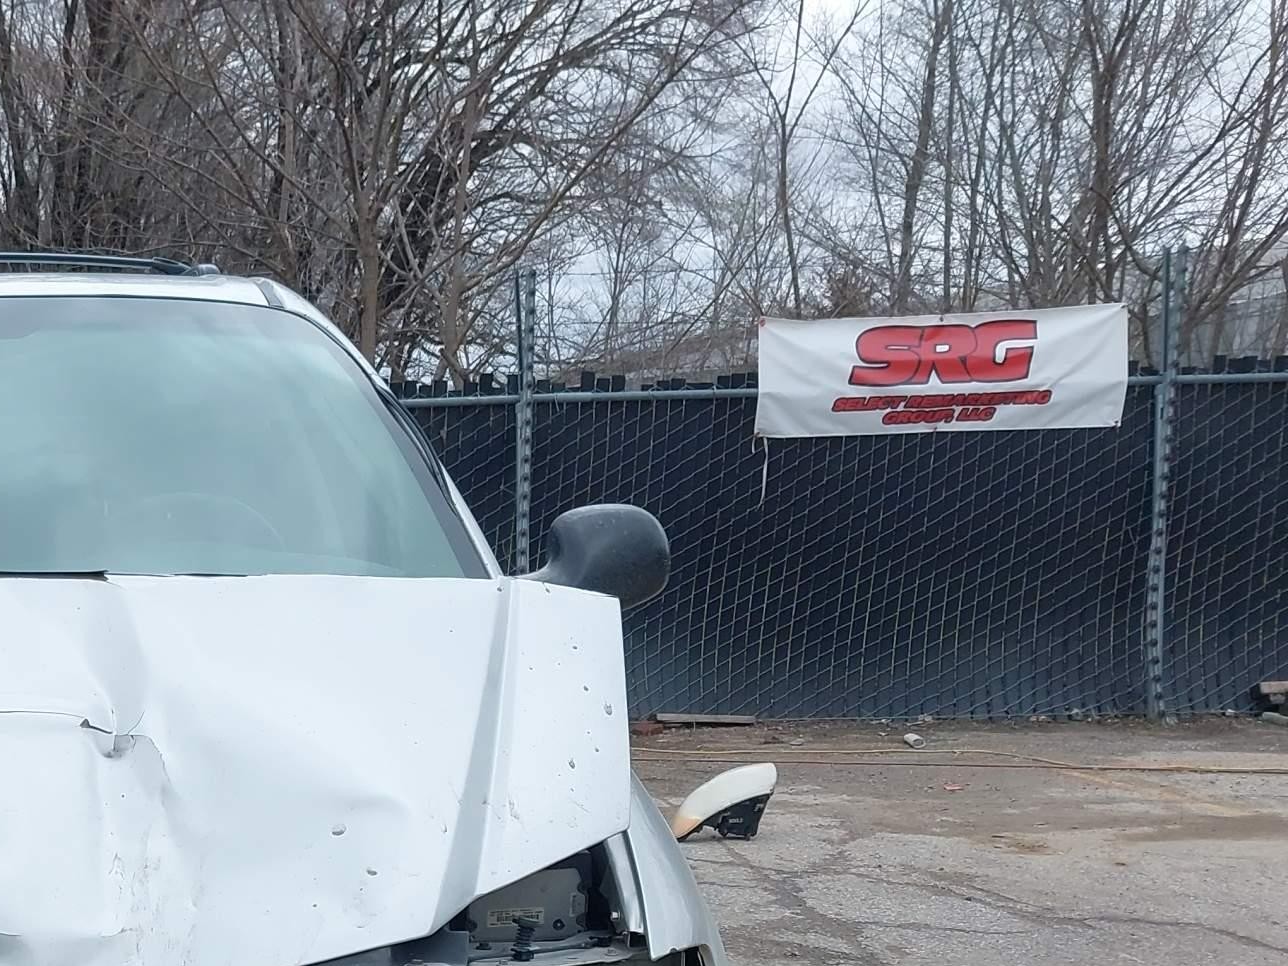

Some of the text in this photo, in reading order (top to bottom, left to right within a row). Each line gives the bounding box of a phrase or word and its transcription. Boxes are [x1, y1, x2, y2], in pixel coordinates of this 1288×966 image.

[848, 319, 1039, 387] SRG
[832, 395, 908, 412] SELECT
[955, 407, 997, 421] LLC
